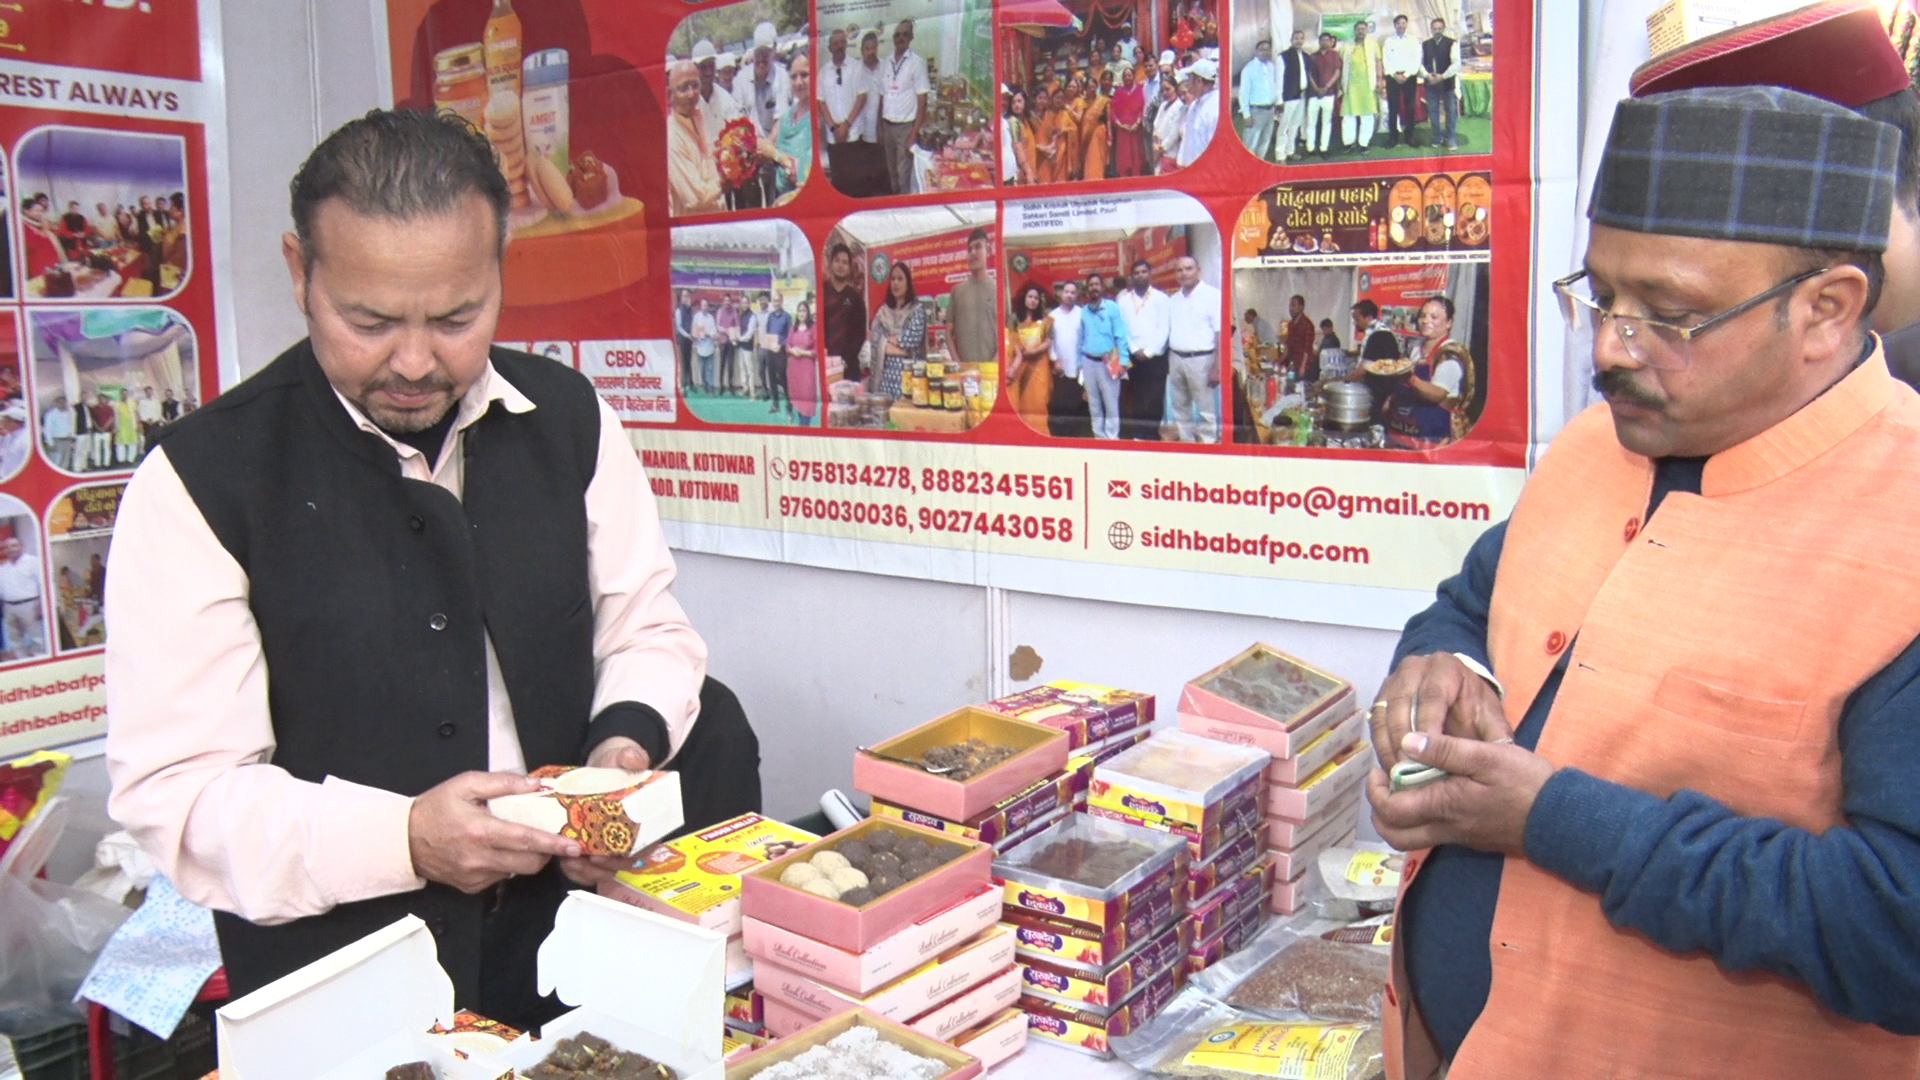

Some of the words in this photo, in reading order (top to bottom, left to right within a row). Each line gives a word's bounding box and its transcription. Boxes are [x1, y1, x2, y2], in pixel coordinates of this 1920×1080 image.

[69, 81, 179, 111] ALWAYS
[605, 350, 646, 367] CBBO
[694, 452, 756, 475] KOTDWAR
[788, 460, 917, 494] 9758134278,
[922, 467, 1073, 501] 8882345561
[679, 480, 740, 503] KOTDWAR
[1140, 478, 1490, 520] sidhbabafpo@gmail.com
[779, 496, 914, 533] 9760030036,
[919, 506, 1074, 543] 9027443058
[1140, 526, 1370, 564] sidhbabafpo.com
